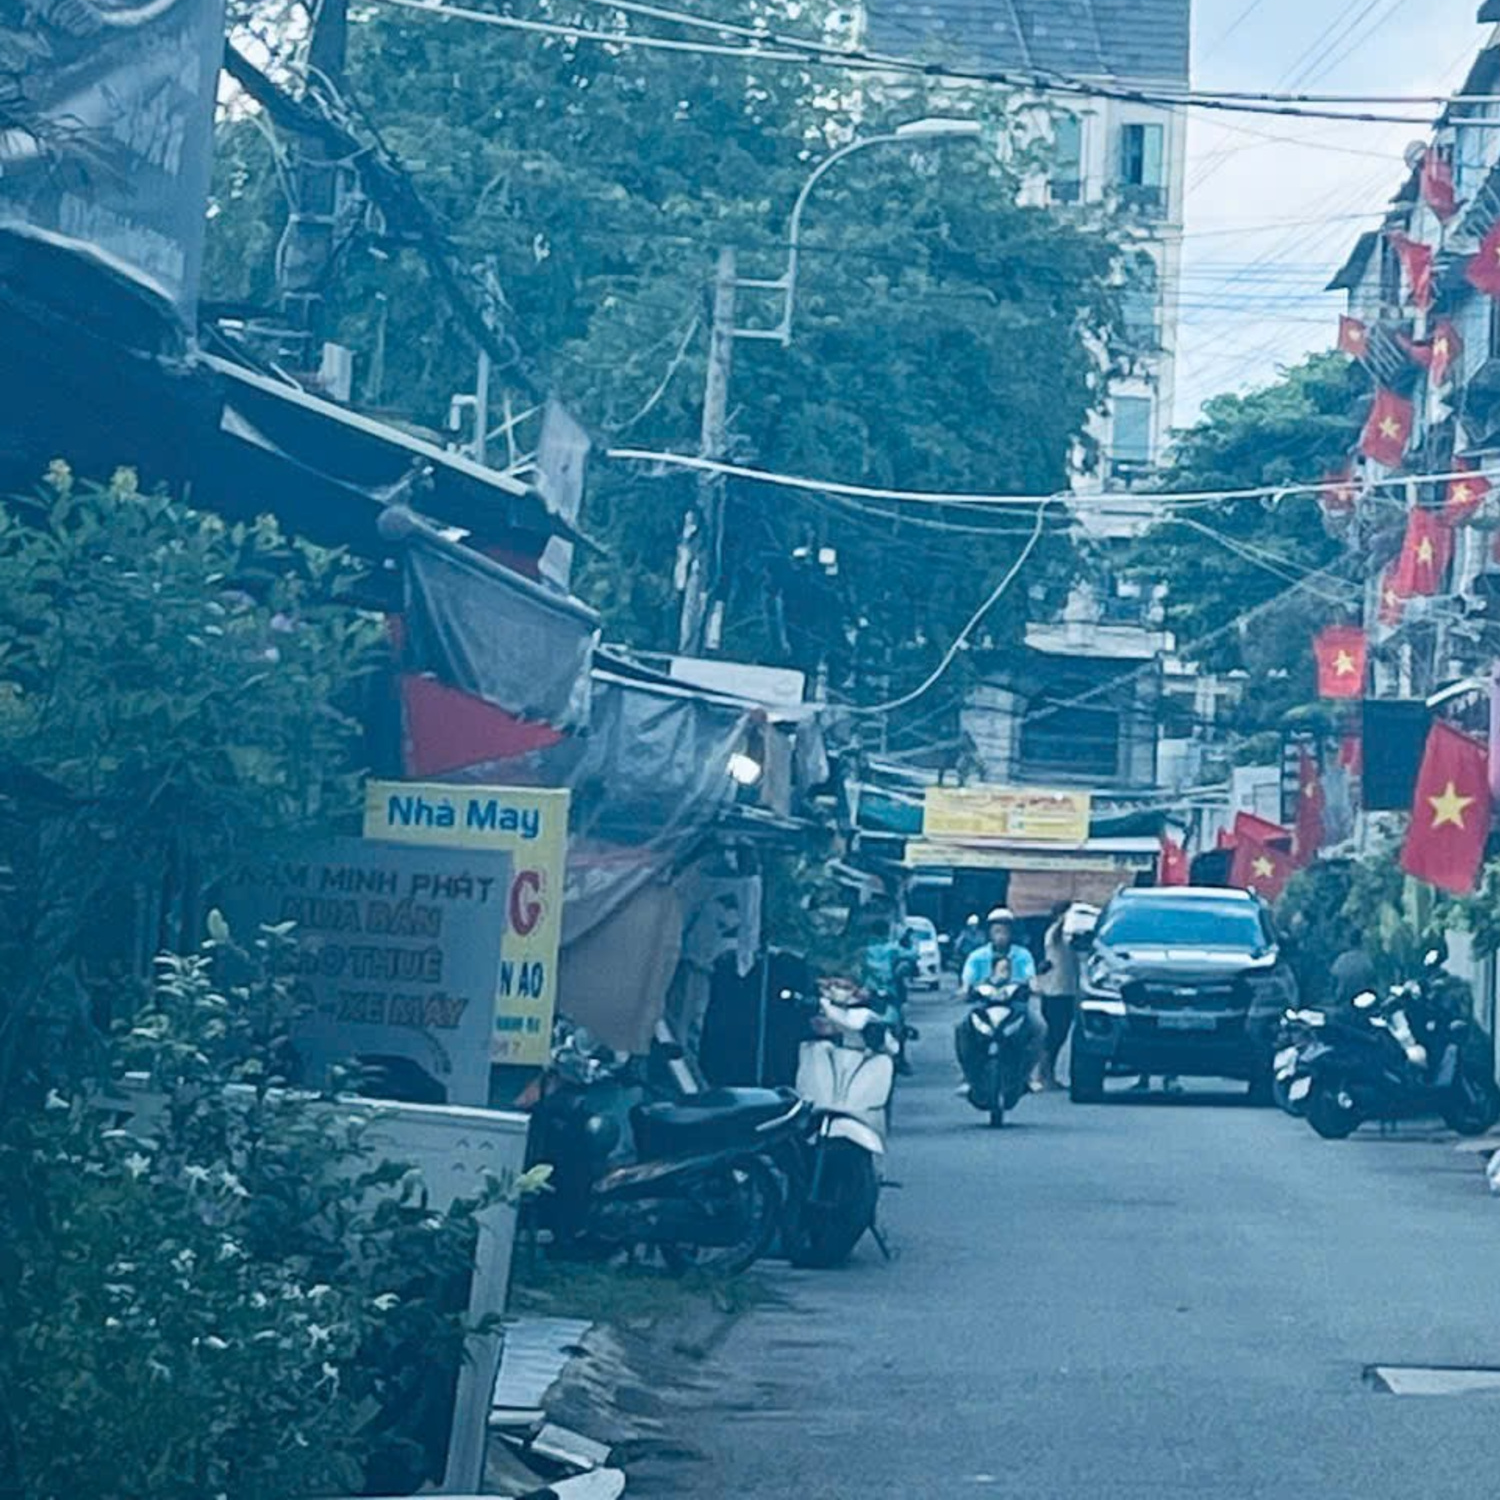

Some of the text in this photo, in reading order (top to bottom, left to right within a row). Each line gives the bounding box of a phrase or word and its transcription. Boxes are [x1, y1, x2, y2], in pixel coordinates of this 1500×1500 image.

[387, 796, 540, 840] Nhà May
[322, 868, 397, 900] MINH
[412, 866, 494, 904] PHÁT
[366, 893, 443, 939] BÁN
[349, 944, 444, 983] THUÊ
[389, 988, 470, 1030] MÁY
